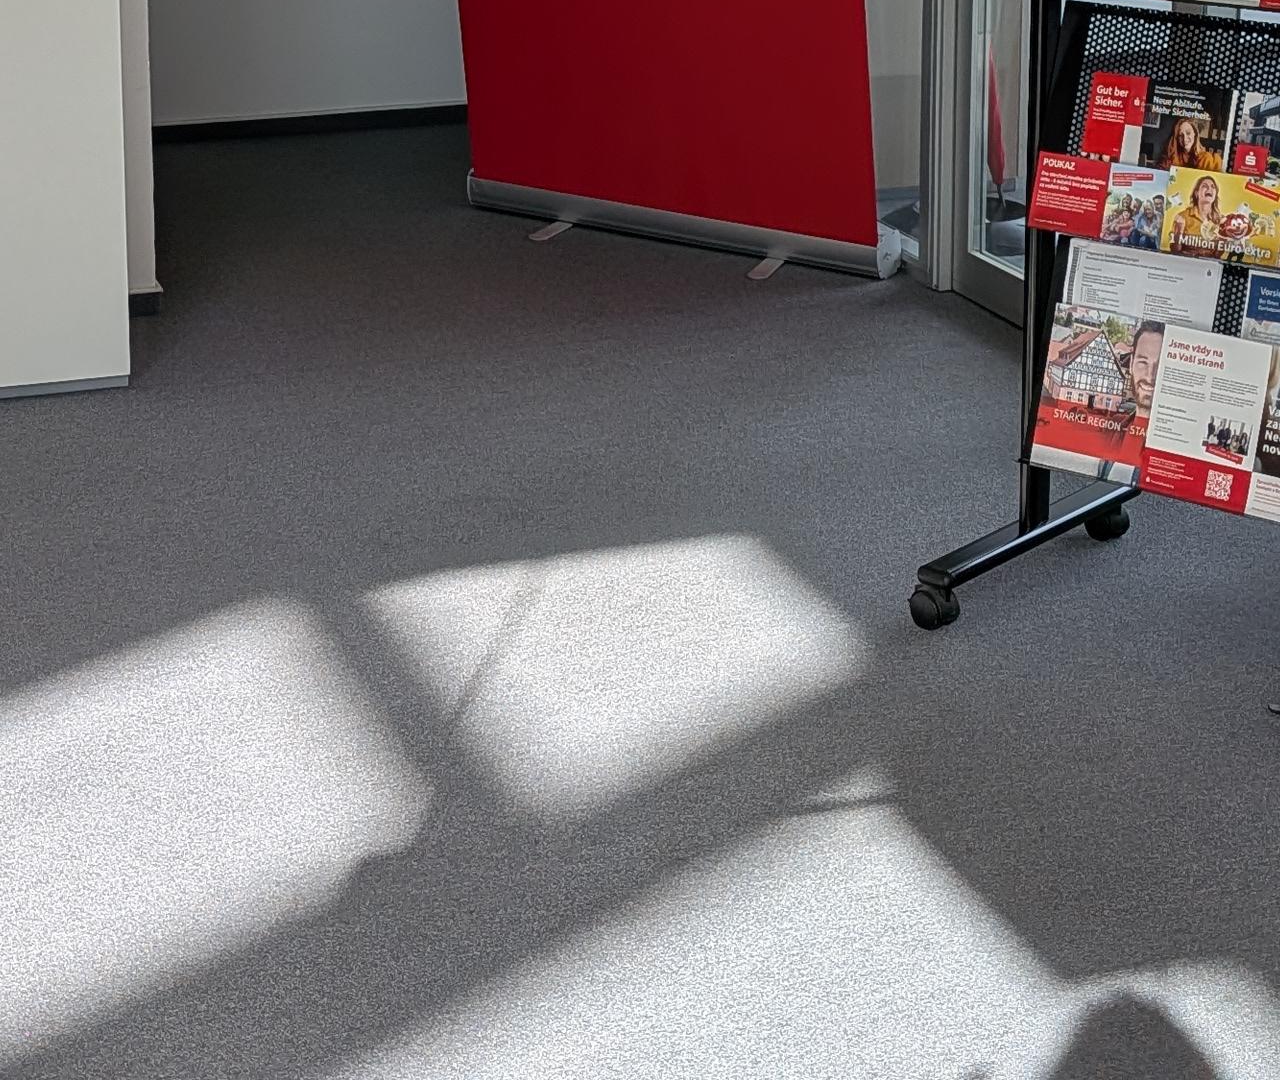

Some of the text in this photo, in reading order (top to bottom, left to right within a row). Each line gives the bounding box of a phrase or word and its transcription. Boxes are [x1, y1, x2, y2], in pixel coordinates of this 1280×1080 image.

[1097, 85, 1113, 96] Gut
[1095, 96, 1124, 108] Sicher.
[1153, 96, 1204, 110] Neue Abläufe.
[1151, 105, 1172, 115] Mehr
[1043, 158, 1075, 170] POUKAZ
[1179, 234, 1215, 249] Million
[1217, 241, 1242, 253] Euro
[1244, 244, 1271, 258] extra
[1168, 339, 1223, 357] Jsme vždy na
[1197, 357, 1225, 370] straně
[1053, 408, 1086, 424] STARKE
[1087, 416, 1121, 431] REGION
[1129, 425, 1145, 437] STA
